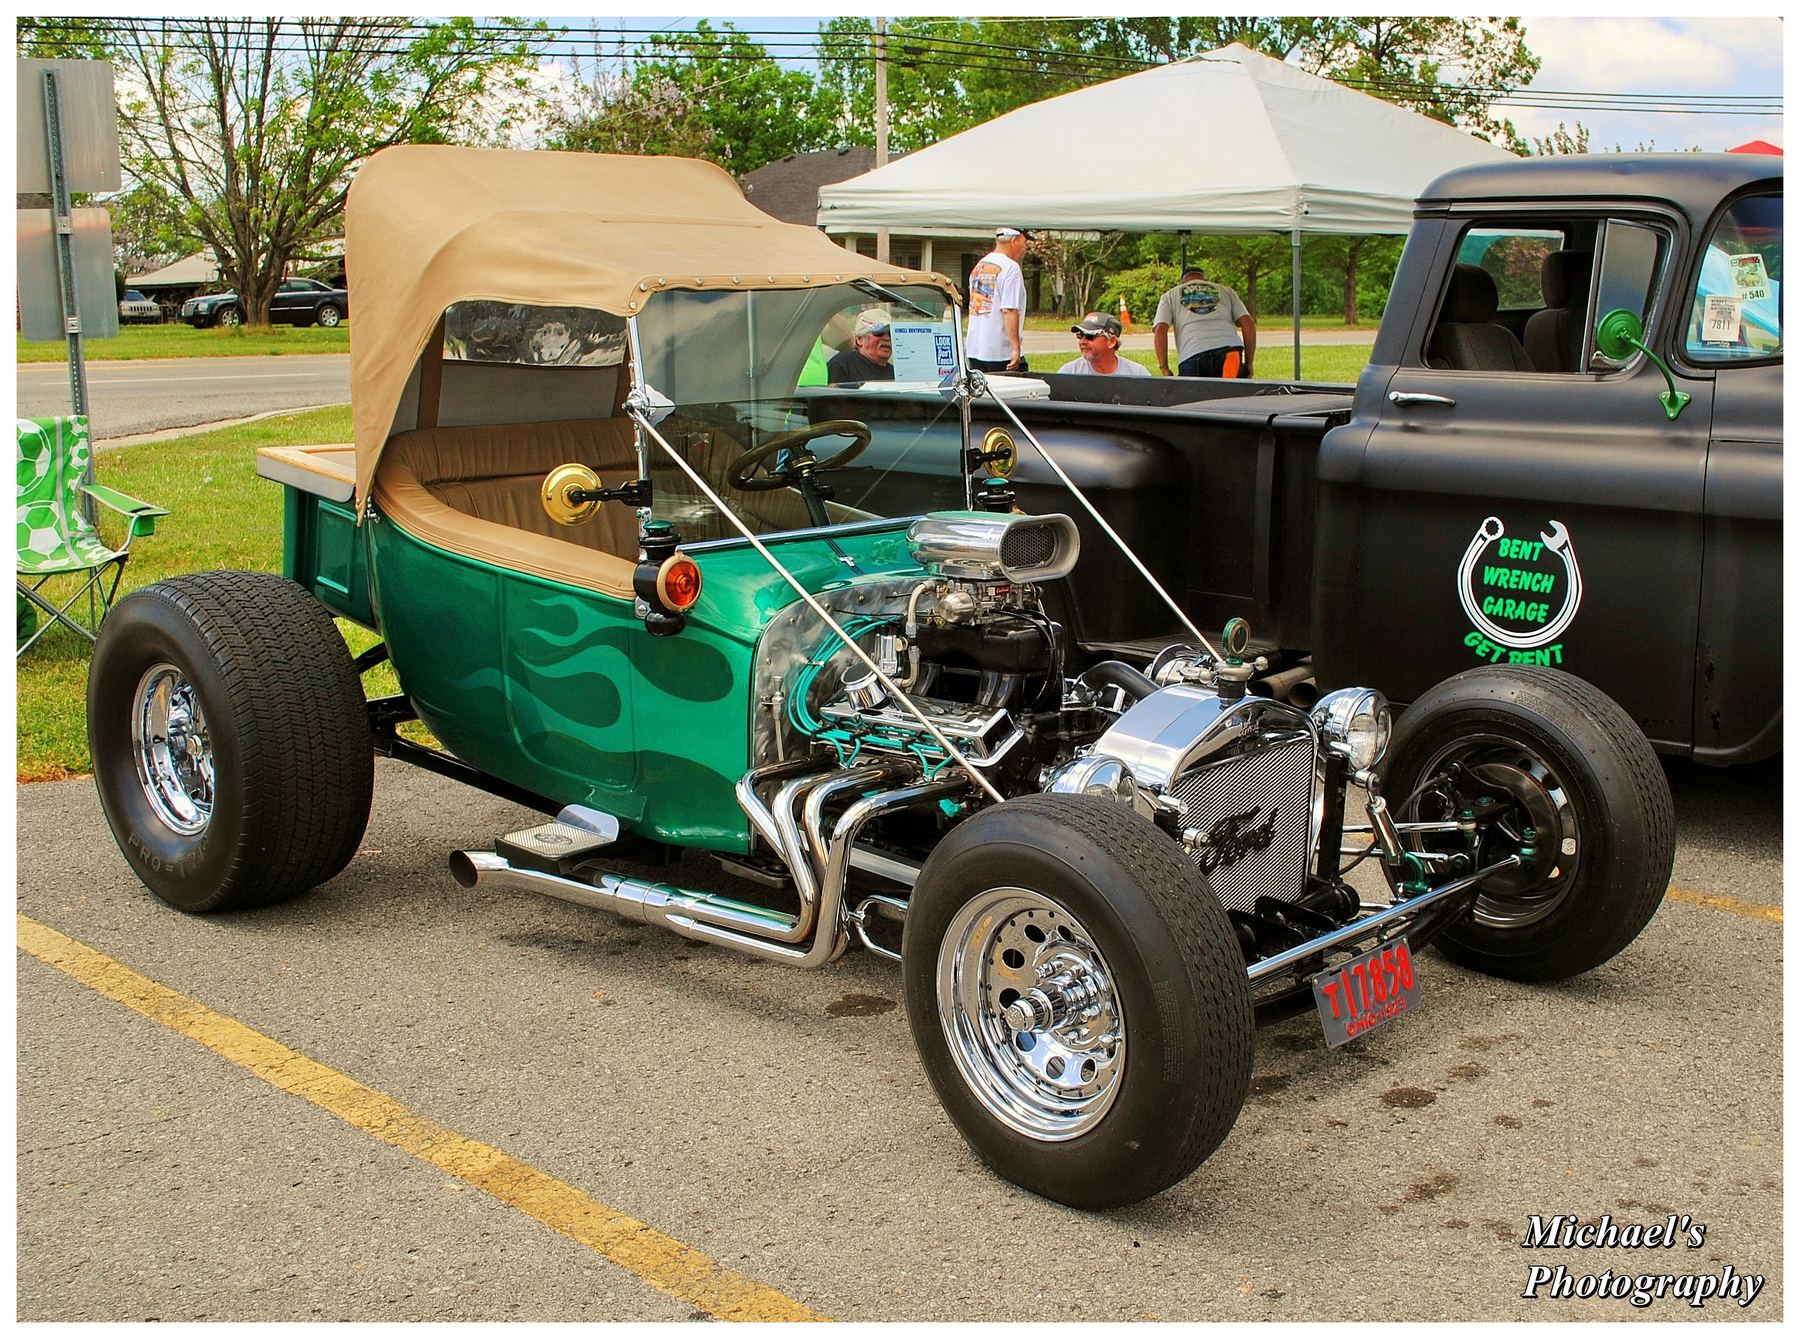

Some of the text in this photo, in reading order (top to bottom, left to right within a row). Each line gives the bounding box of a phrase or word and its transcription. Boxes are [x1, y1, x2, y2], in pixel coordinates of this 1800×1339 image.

[1749, 289, 1765, 299] 540
[1711, 319, 1730, 330] 7811
[936, 336, 951, 346] LOOK
[1498, 538, 1544, 561] BENT
[1483, 565, 1555, 594] WRENCH
[1482, 596, 1549, 623] GARAGE
[1464, 631, 1507, 663] GET
[1200, 806, 1278, 875] Ford
